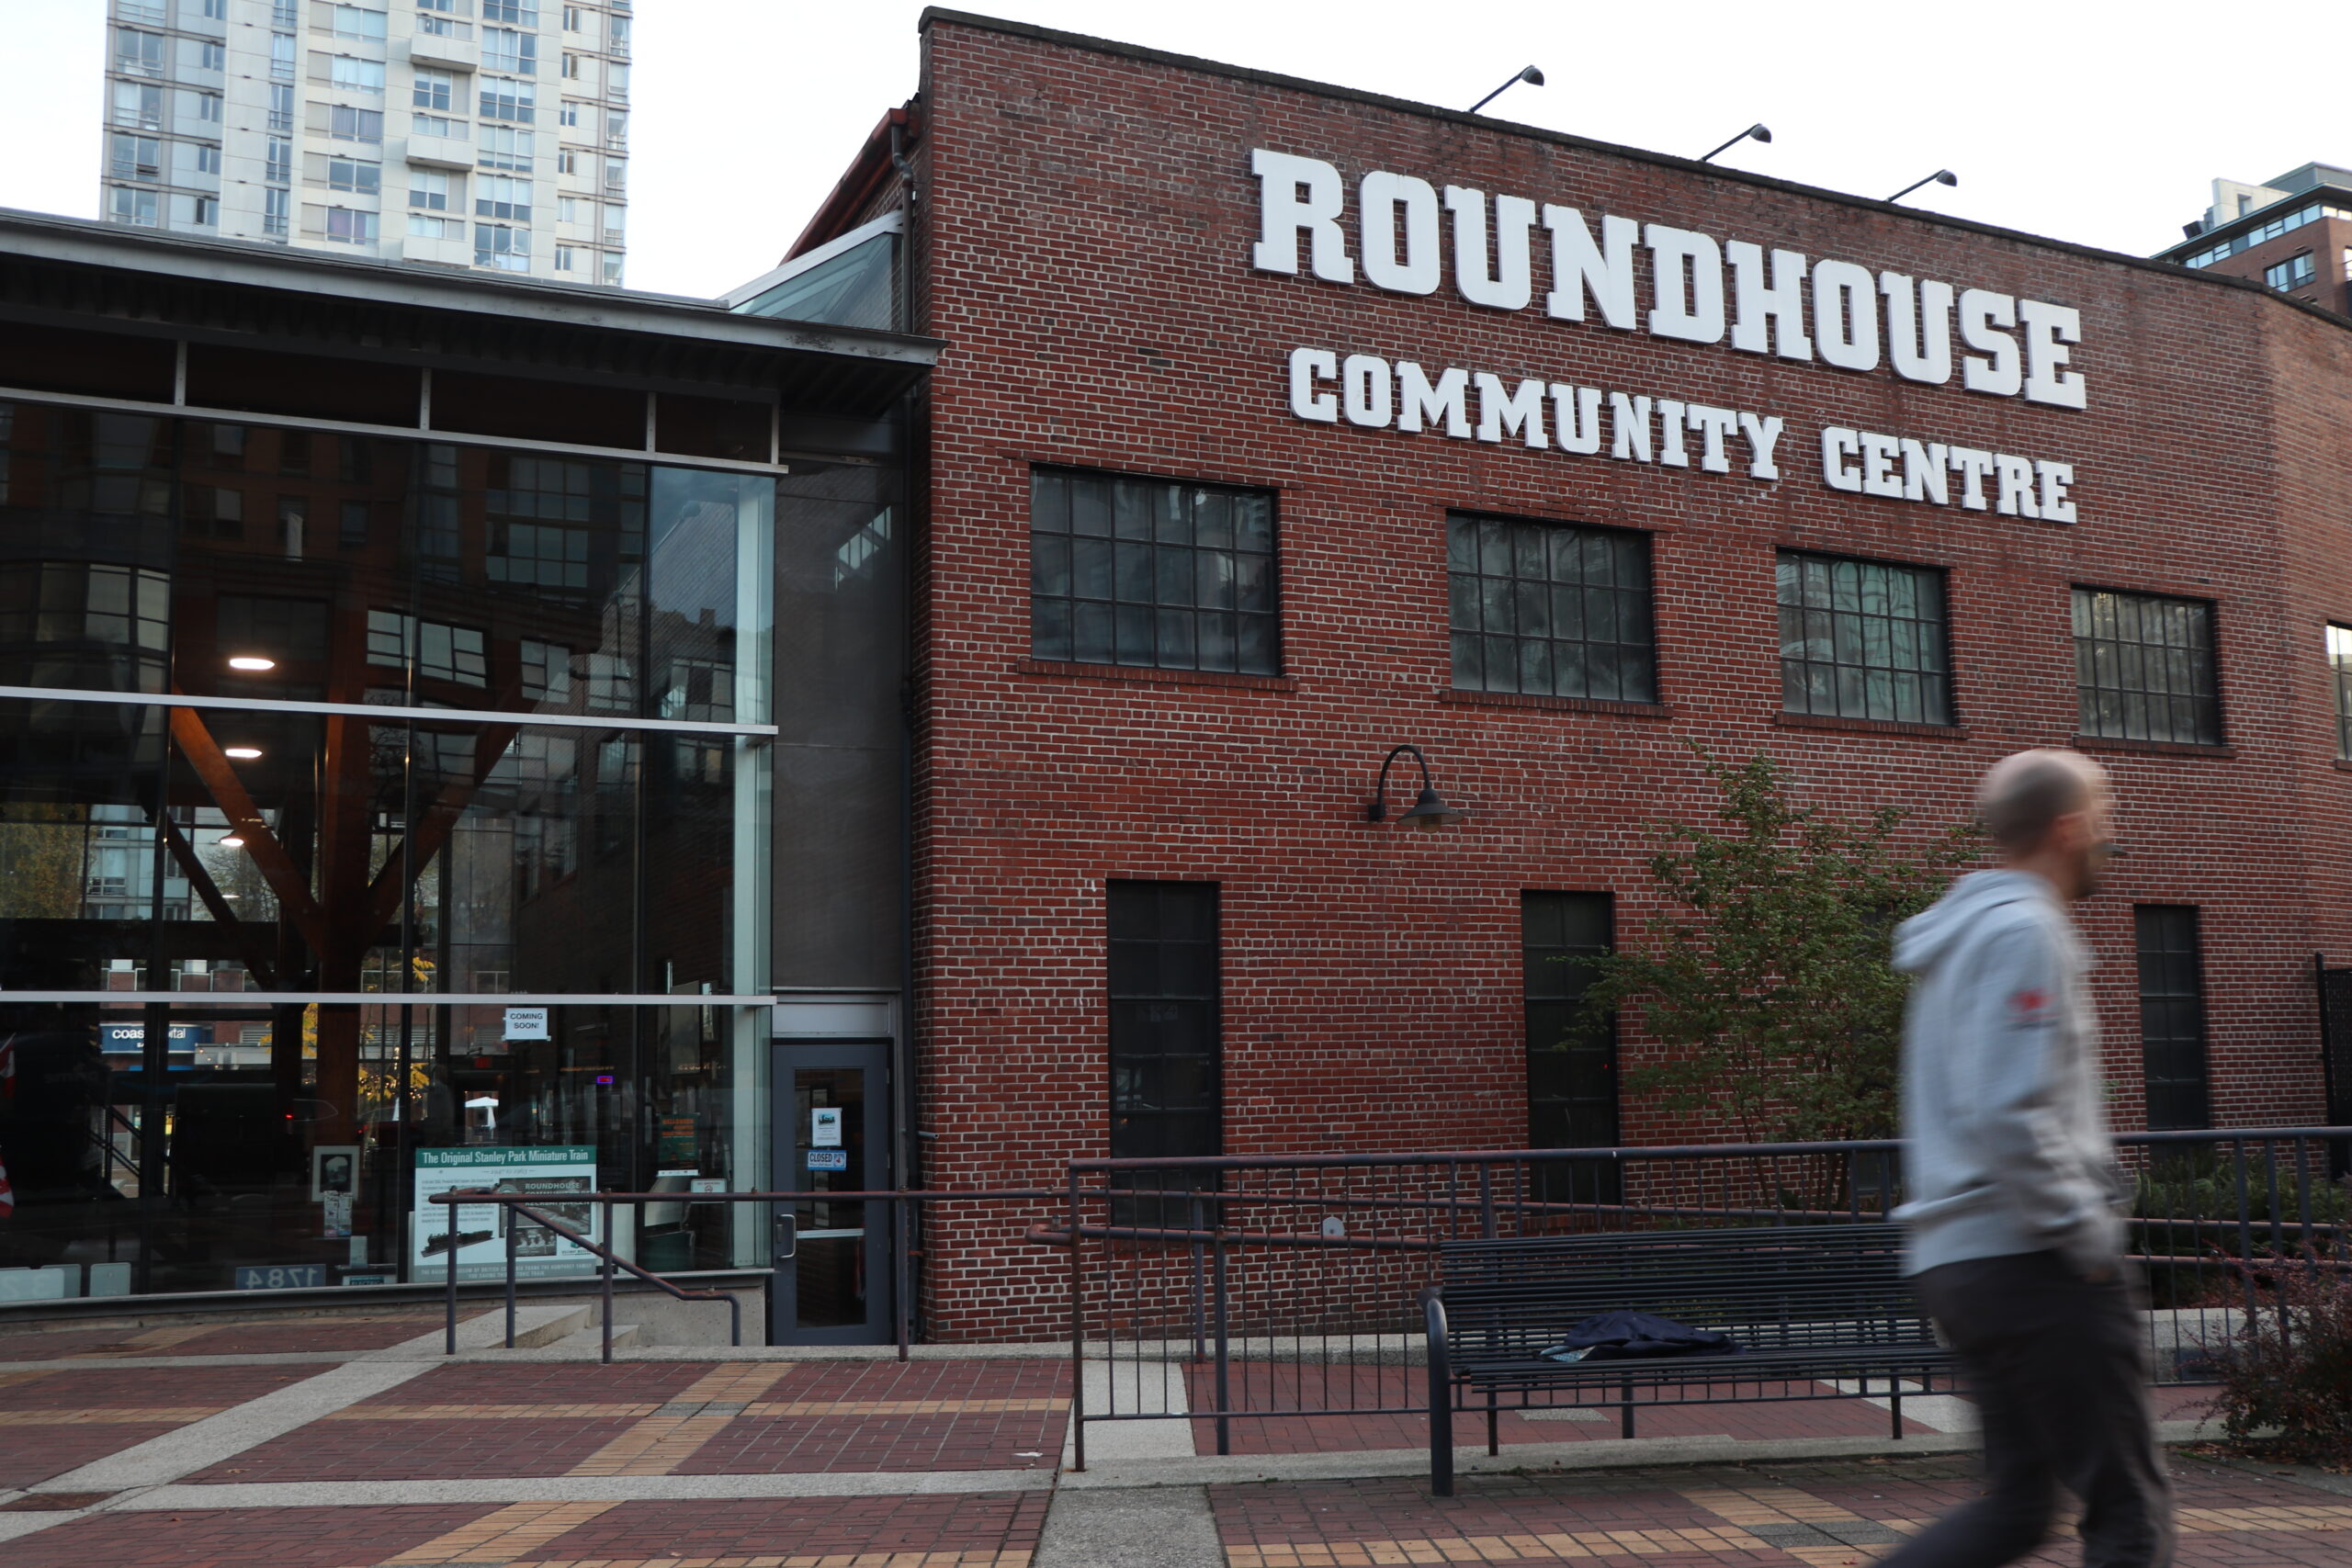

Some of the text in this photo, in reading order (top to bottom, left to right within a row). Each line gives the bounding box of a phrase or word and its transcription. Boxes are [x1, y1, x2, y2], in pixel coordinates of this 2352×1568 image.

[1250, 147, 2087, 411] ROUNDHOUSE
[1288, 346, 2077, 525] COMMUNITY CENTRE
[112, 1029, 145, 1039] coas
[423, 1148, 589, 1166] The Original Stanley Park Miniature Train
[809, 1153, 833, 1163] CLOSED
